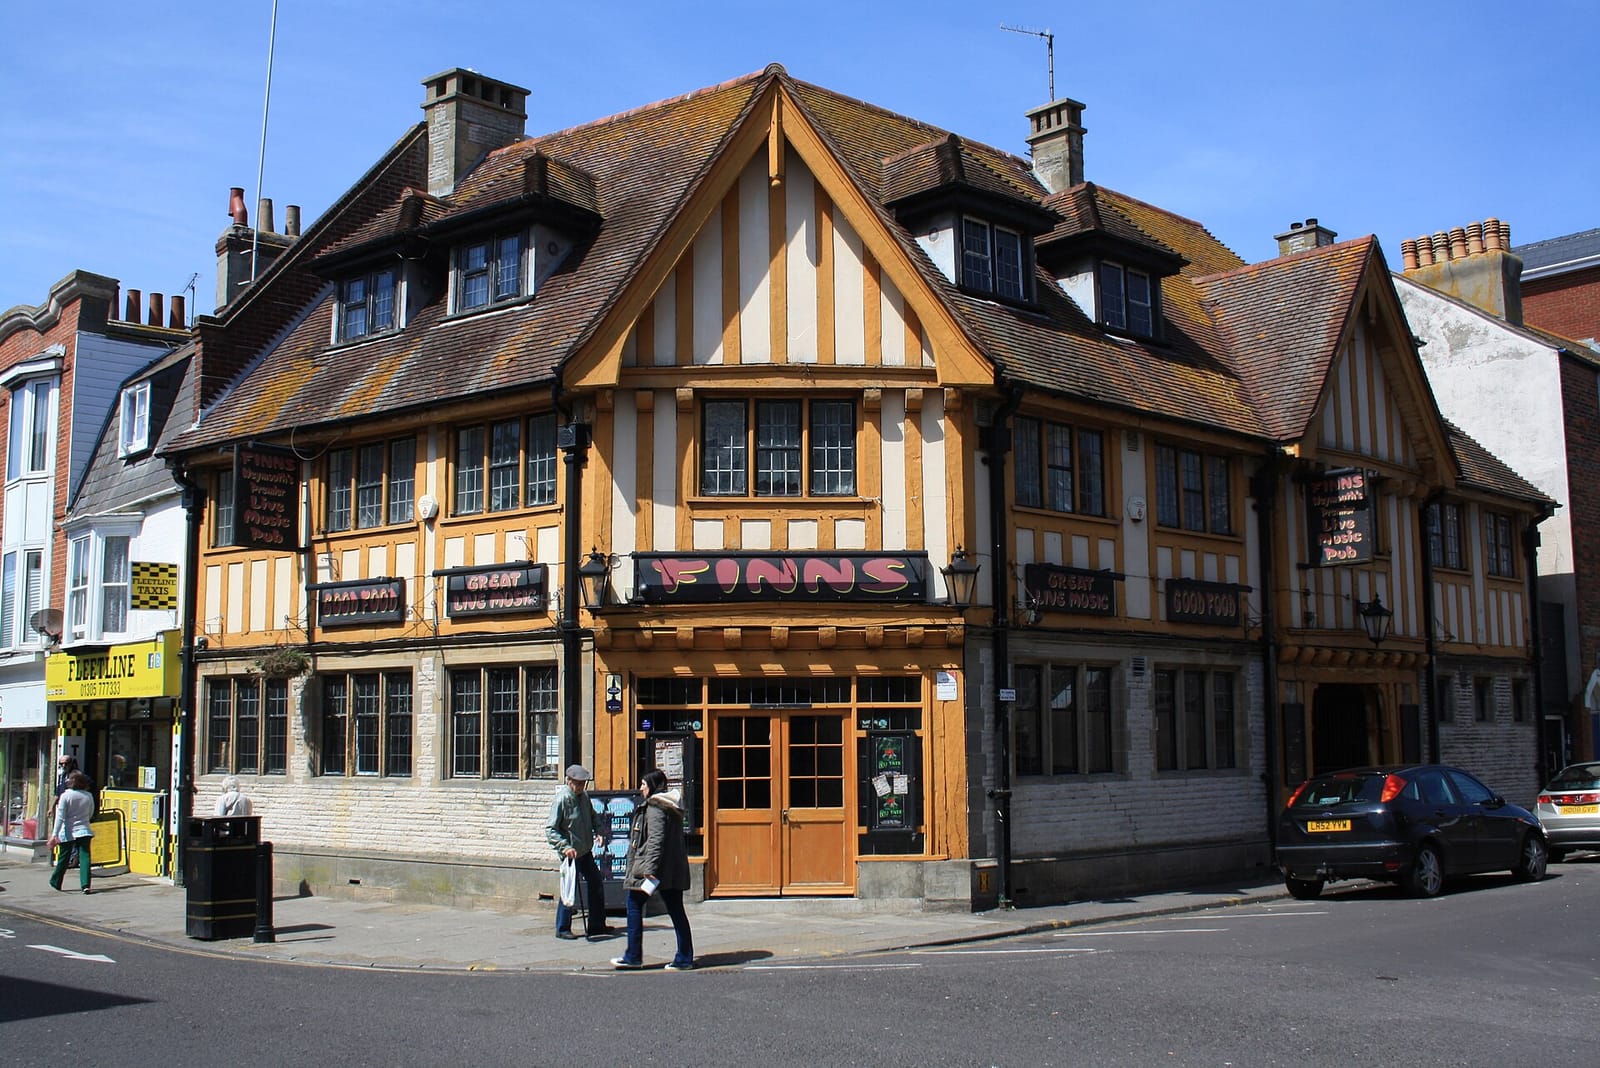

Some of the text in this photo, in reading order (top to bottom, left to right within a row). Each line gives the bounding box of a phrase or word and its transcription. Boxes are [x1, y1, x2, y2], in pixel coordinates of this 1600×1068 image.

[241, 452, 295, 471] FINNS
[250, 495, 285, 512] Live
[243, 510, 290, 528] Music
[1321, 518, 1355, 532] Live
[250, 527, 284, 543] Pub
[1317, 530, 1362, 546] Music
[1324, 545, 1357, 560] Pub
[466, 571, 521, 592] GREAT
[651, 558, 909, 594] FINNS
[1048, 574, 1095, 592] GREAT
[137, 585, 169, 595] TAXIS
[322, 587, 399, 618] GOOD FOOD
[453, 589, 537, 611] LIVE MUSIC
[1069, 592, 1109, 610] MUSIC
[1174, 591, 1236, 617] GOOD FOOD
[68, 654, 136, 682] FLEETLINE
[80, 682, 97, 696] 01305
[99, 681, 121, 696] 777333
